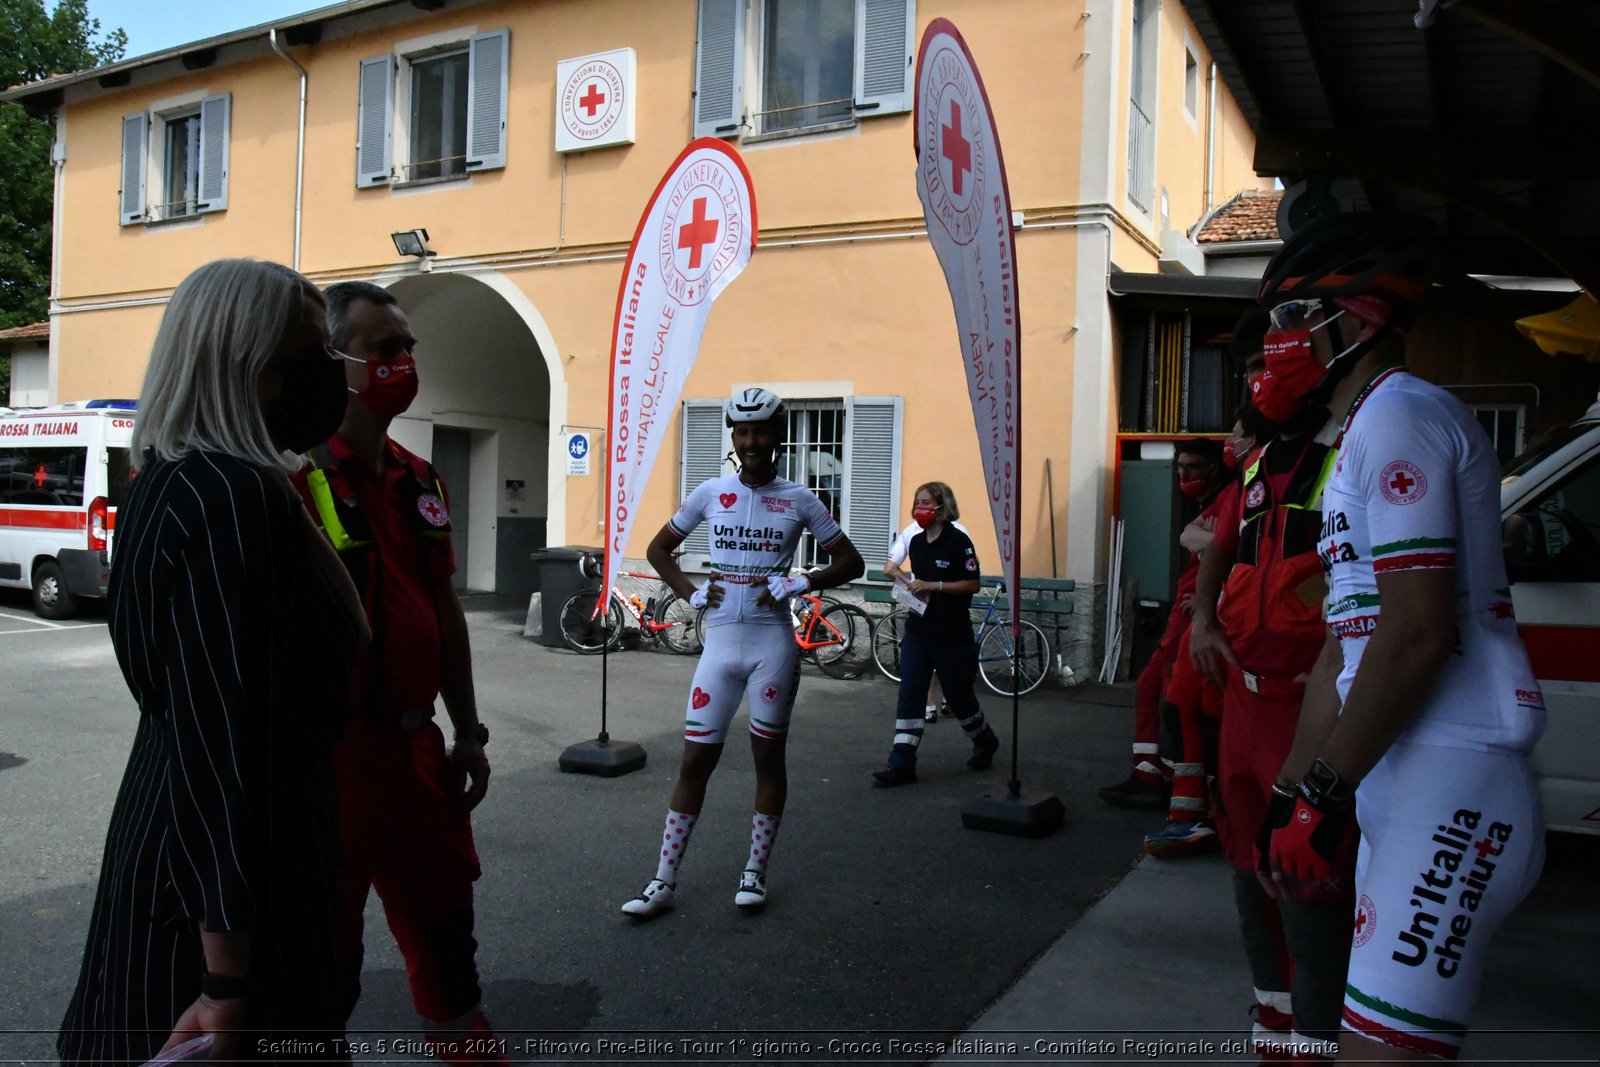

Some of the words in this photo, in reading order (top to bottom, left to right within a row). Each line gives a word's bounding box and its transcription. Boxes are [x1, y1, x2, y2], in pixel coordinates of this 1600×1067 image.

[565, 65, 596, 112] CONVENZIONE
[598, 65, 606, 74] DI
[605, 69, 620, 104] GINEVRA
[570, 121, 579, 130] 22
[683, 165, 724, 191] GINEVRA
[713, 212, 740, 272] AGOSTO
[618, 262, 647, 365] Italiana
[32, 422, 78, 436] ITALIANA
[112, 419, 134, 428] CRO
[615, 376, 631, 463] Rossa
[714, 524, 784, 540] Un'Italia
[715, 538, 737, 550] che
[740, 541, 781, 553] aiuta
[1392, 807, 1482, 967] Un'Italia
[1433, 913, 1472, 979] che
[1458, 820, 1513, 912] aiuta
